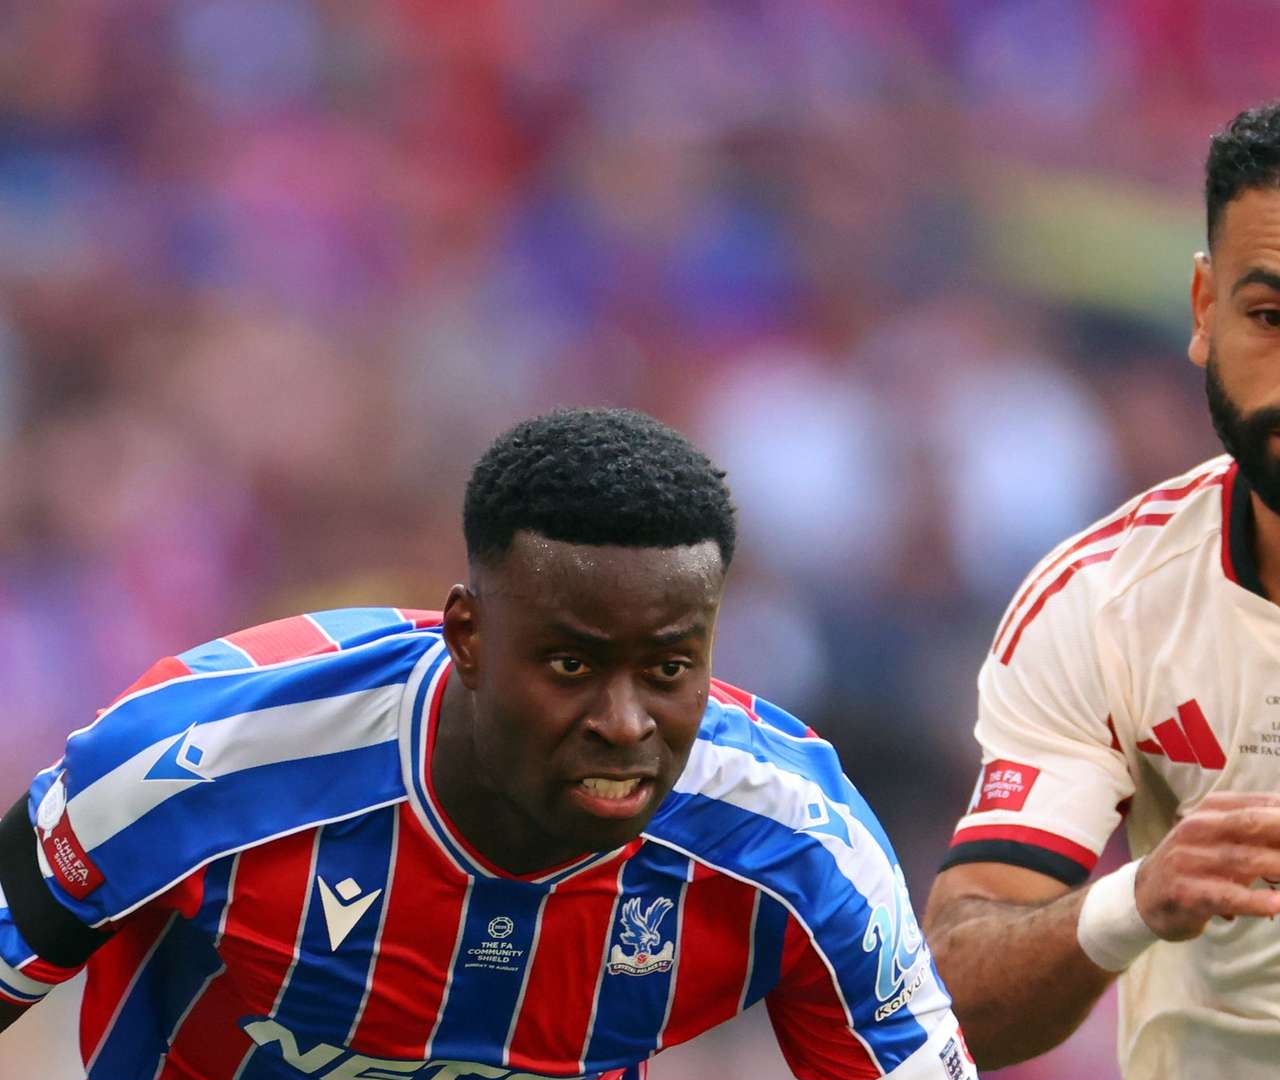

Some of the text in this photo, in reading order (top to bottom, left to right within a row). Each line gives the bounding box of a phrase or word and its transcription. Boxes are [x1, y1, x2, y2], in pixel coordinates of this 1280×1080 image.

[1239, 744, 1258, 754] THE
[1260, 746, 1272, 756] FA
[1003, 769, 1022, 784] FA
[54, 837, 89, 887] COMMUNITY
[60, 837, 89, 881] THE FA
[54, 852, 75, 883] SHIELD
[481, 941, 513, 950] THE FA
[467, 948, 524, 957] COMMUNITY
[477, 955, 510, 963] SHIELD
